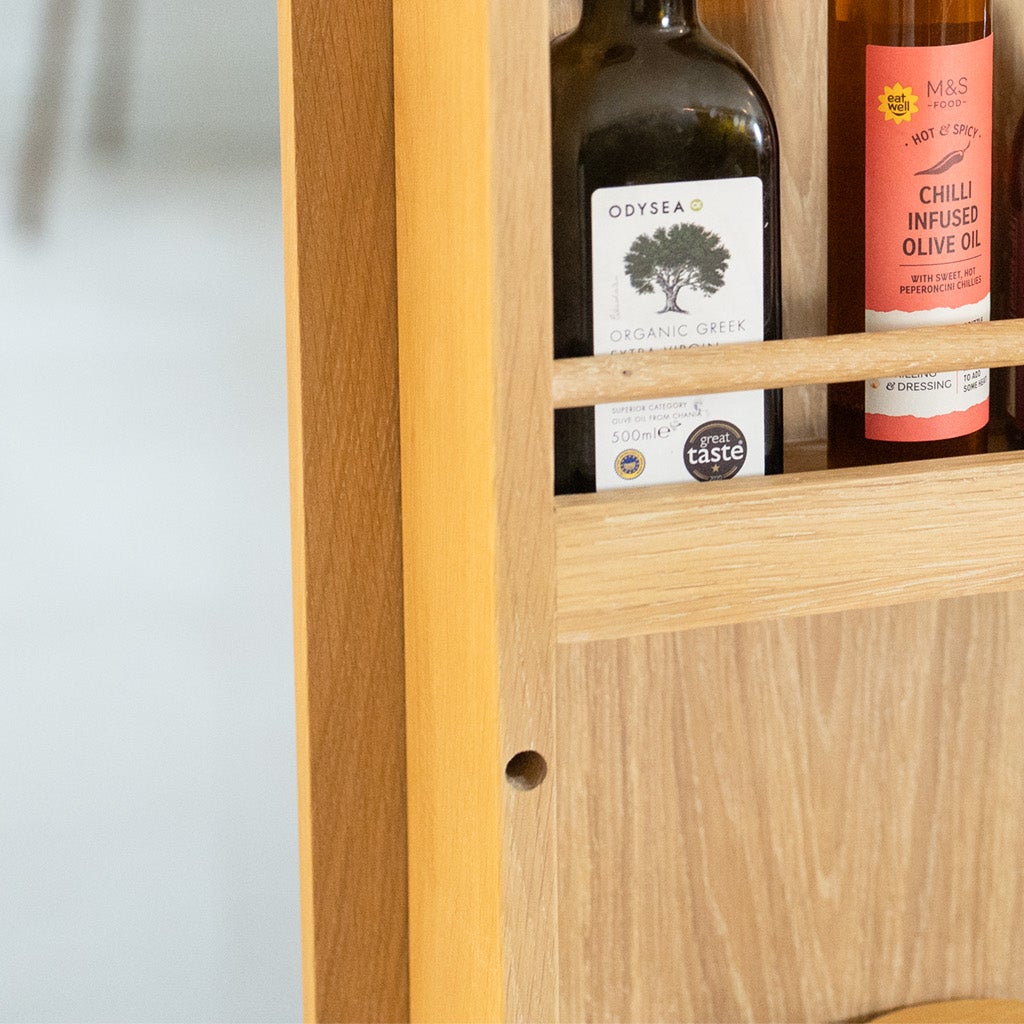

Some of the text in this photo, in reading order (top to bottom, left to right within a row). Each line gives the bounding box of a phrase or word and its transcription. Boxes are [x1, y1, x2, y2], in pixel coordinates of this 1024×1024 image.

[927, 77, 968, 97] M&S
[887, 93, 906, 103] eat
[887, 101, 910, 112] well
[912, 123, 979, 145] HOT & SPICY
[919, 180, 972, 204] CHILLI
[608, 201, 685, 218] ODYSEA
[908, 205, 978, 230] INFUSED
[902, 229, 981, 256] OLIVE OIL
[911, 274, 933, 283] WITH
[964, 267, 976, 277] HOT
[900, 275, 982, 294] PEPERONCINI CHILLIES
[610, 319, 746, 342] ORGANIC GREEK
[886, 379, 952, 391] & DRESSING
[963, 373, 971, 382] TO
[963, 381, 978, 393] SOME
[612, 402, 687, 415] SUPERIOR CATEGORY
[612, 417, 631, 425] OLIVE
[634, 416, 646, 424] OIL
[700, 432, 730, 448] great
[687, 444, 744, 465] taste
